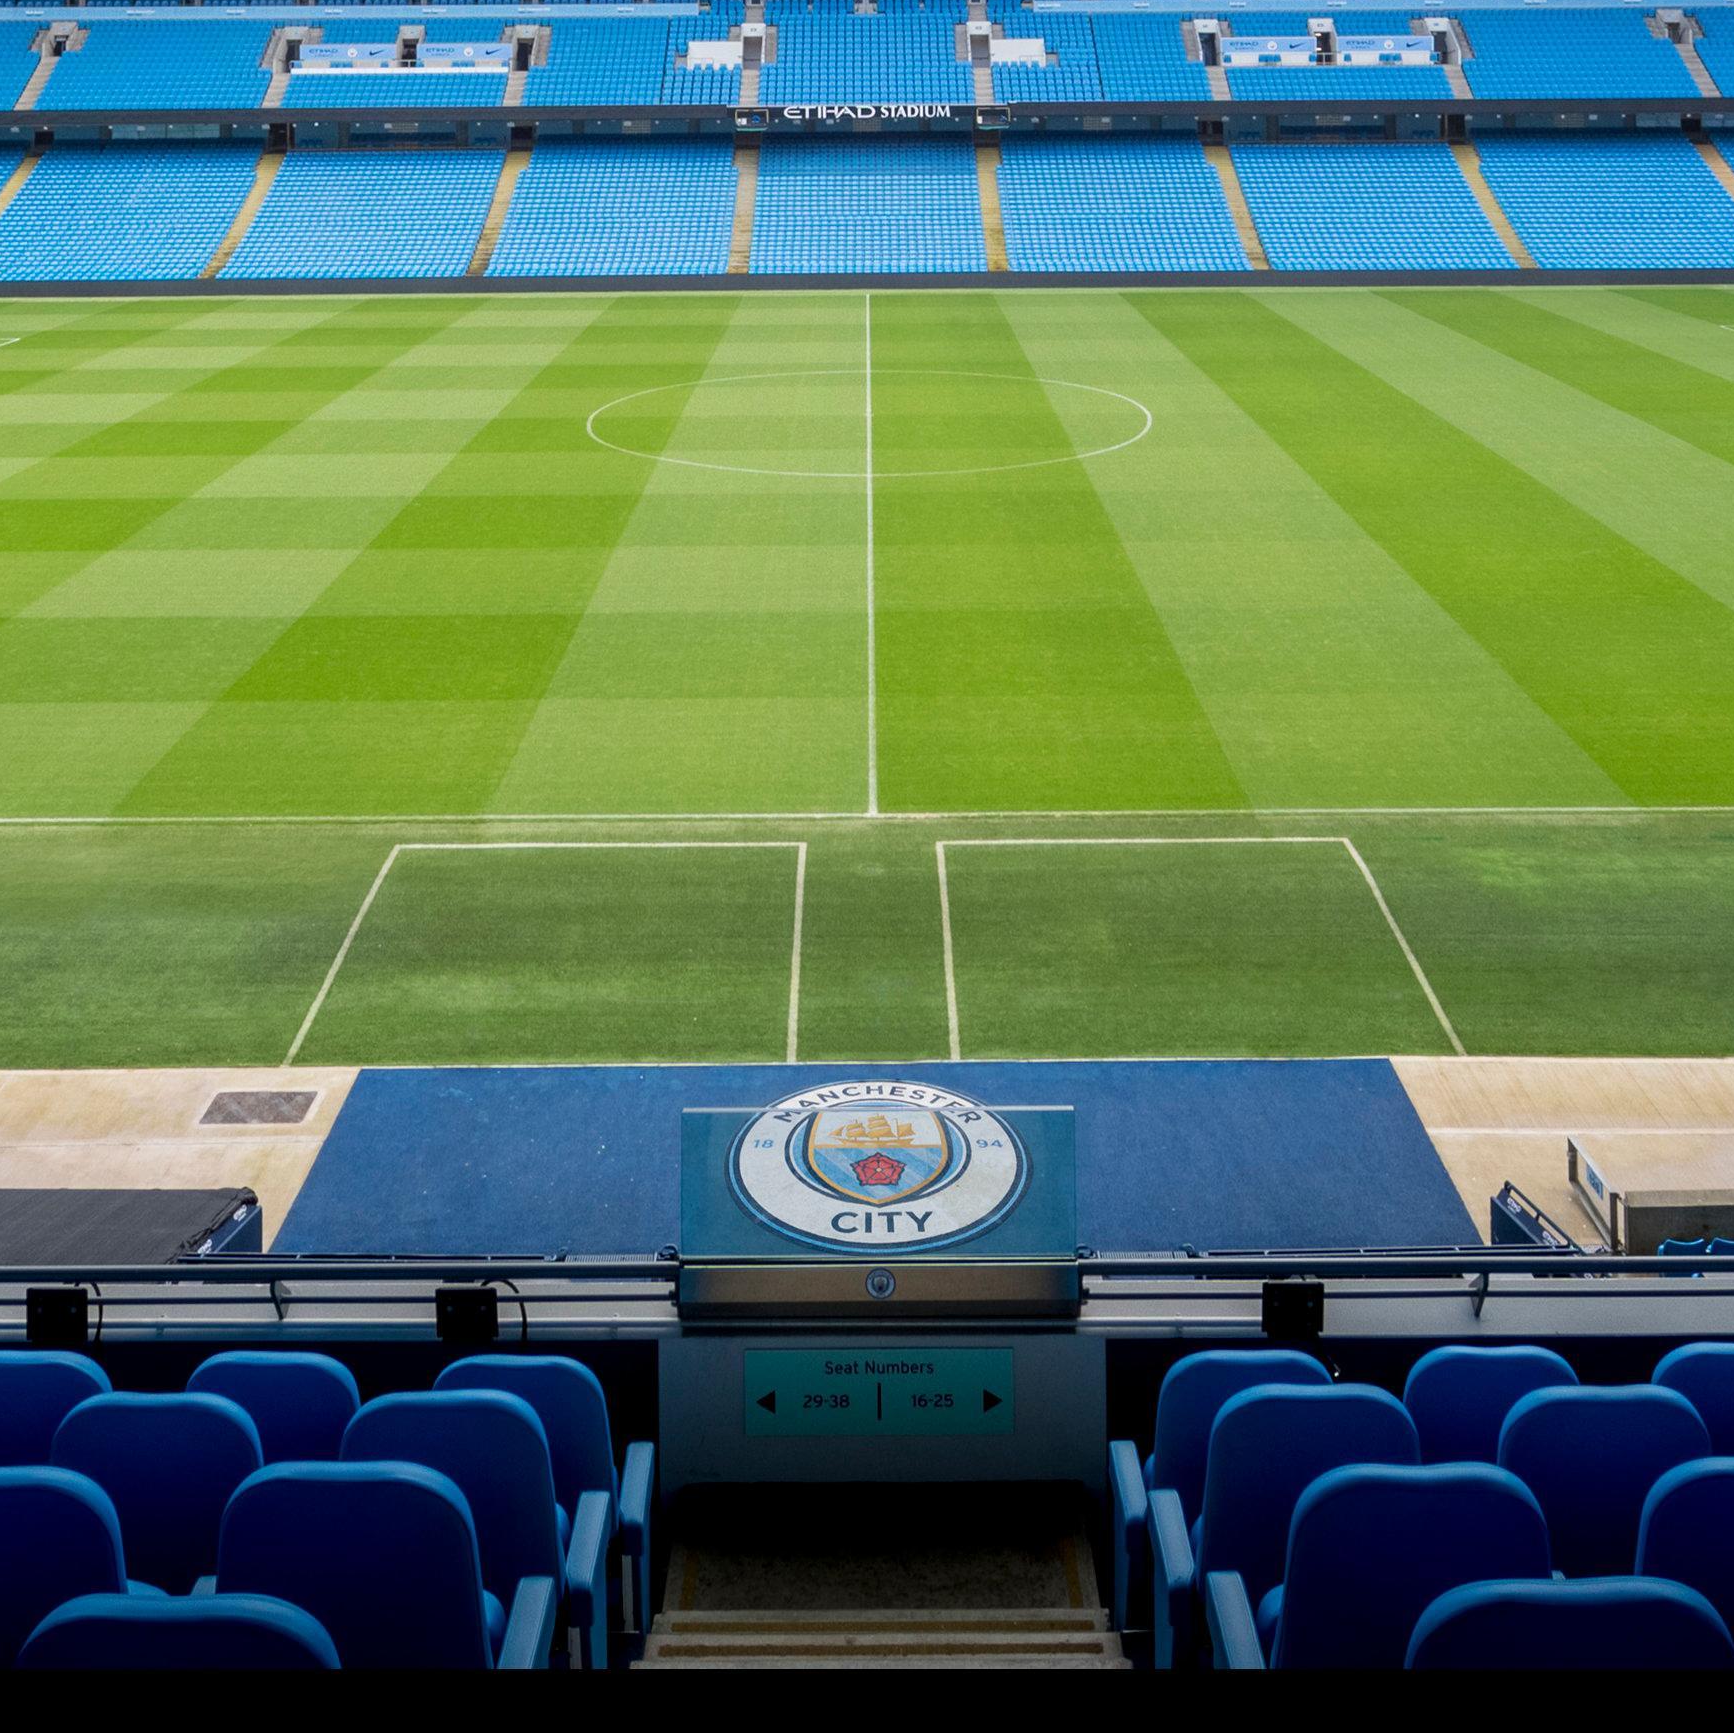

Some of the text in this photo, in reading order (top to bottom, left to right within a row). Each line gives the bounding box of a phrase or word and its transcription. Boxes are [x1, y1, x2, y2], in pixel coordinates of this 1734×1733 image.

[783, 105, 951, 118] ETIHAD STADIUM
[773, 1085, 982, 1124] MANCHESTER
[753, 1138, 773, 1149] 18
[975, 1138, 1004, 1149] 94
[831, 1211, 933, 1234] CITY
[824, 1360, 934, 1375] Seat Numbers
[802, 1395, 850, 1409] 29-38
[912, 1394, 954, 1408] 16-25
